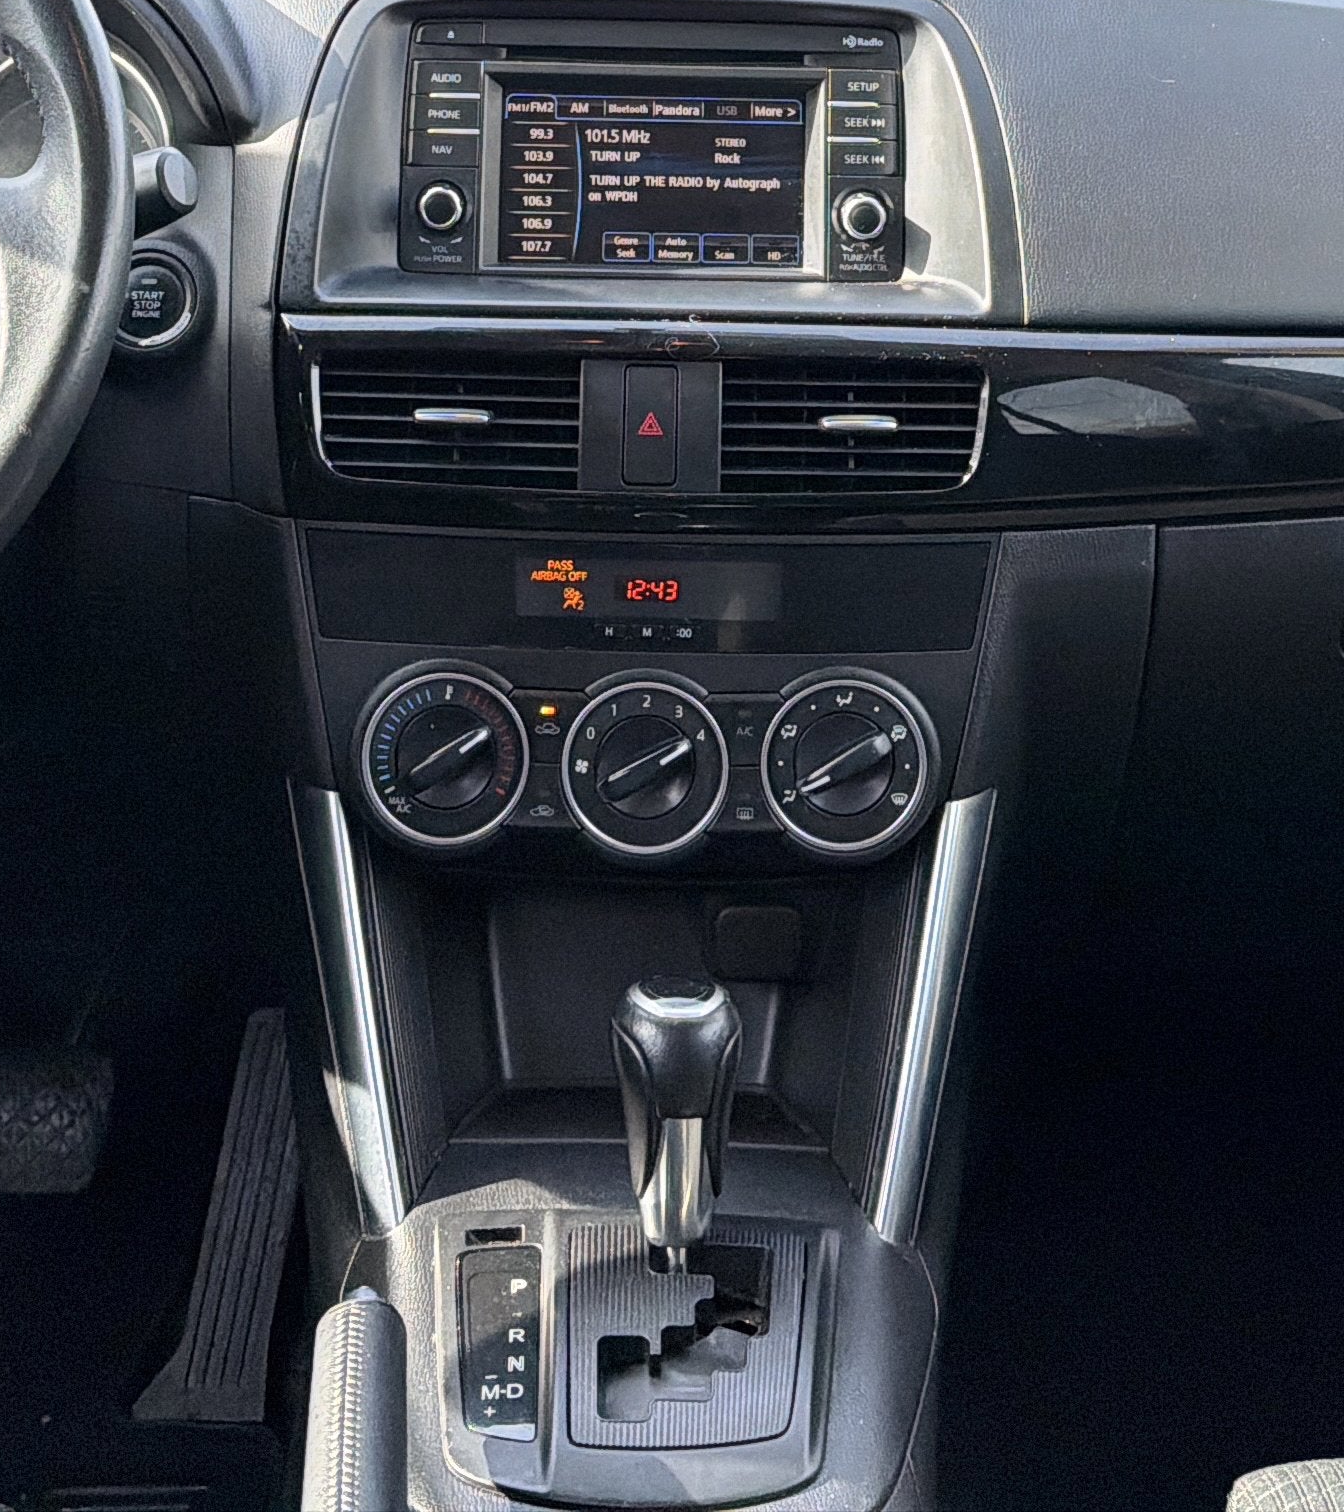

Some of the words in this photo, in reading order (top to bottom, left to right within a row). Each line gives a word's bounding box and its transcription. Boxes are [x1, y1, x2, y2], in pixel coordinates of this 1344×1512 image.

[857, 38, 884, 47] Radio
[431, 74, 461, 83] AUDIO
[847, 81, 879, 92] SETUP
[570, 103, 589, 114] AM
[608, 104, 648, 114] Bluetooth
[655, 105, 700, 116] Pandora
[716, 106, 738, 116] USB
[755, 106, 783, 117] More
[428, 109, 460, 119] PHONE
[844, 118, 869, 128] SEEK
[530, 129, 553, 139] 99.3
[585, 129, 620, 143] 101.5
[622, 129, 650, 144] MHz
[715, 138, 746, 148] STEREO
[432, 145, 452, 154] NAV
[523, 151, 554, 161] 103.9
[590, 151, 620, 162] TURN
[625, 151, 641, 162] UP
[714, 153, 741, 164] Rock
[844, 154, 869, 164] SEEK
[523, 173, 553, 184] 104.7
[589, 175, 620, 186] TURN
[624, 176, 640, 186] UP
[644, 176, 666, 187] THE
[669, 176, 703, 187] RADIO
[706, 176, 720, 191] by
[723, 177, 780, 192] Autograph
[522, 196, 552, 206] 106.3
[588, 192, 601, 201] on
[605, 191, 637, 202] WPDH
[521, 218, 552, 229] 106.9
[614, 236, 638, 245] Genre
[665, 237, 687, 246] Auto
[521, 241, 551, 251] 107.7
[616, 248, 636, 258] Seek
[658, 249, 693, 261] Memory
[714, 250, 734, 260] Scan
[768, 251, 781, 260] HD
[432, 255, 462, 263] POWER
[130, 290, 165, 300] START
[133, 300, 161, 310] STOP
[131, 310, 161, 319] ENGINE
[547, 560, 574, 570] PASS
[531, 571, 567, 581] AIRBAG
[568, 571, 588, 581] OFF
[626, 580, 679, 601] 12:43
[605, 627, 614, 636] H
[642, 628, 652, 636] M
[676, 628, 692, 638] :00
[643, 695, 651, 708] 2
[611, 704, 617, 716] 1
[675, 705, 684, 717] 3
[586, 727, 595, 739] 0
[696, 729, 705, 741] 4
[736, 727, 754, 736] A/C
[510, 1278, 527, 1294] P
[508, 1328, 525, 1343] R
[507, 1356, 525, 1372] N
